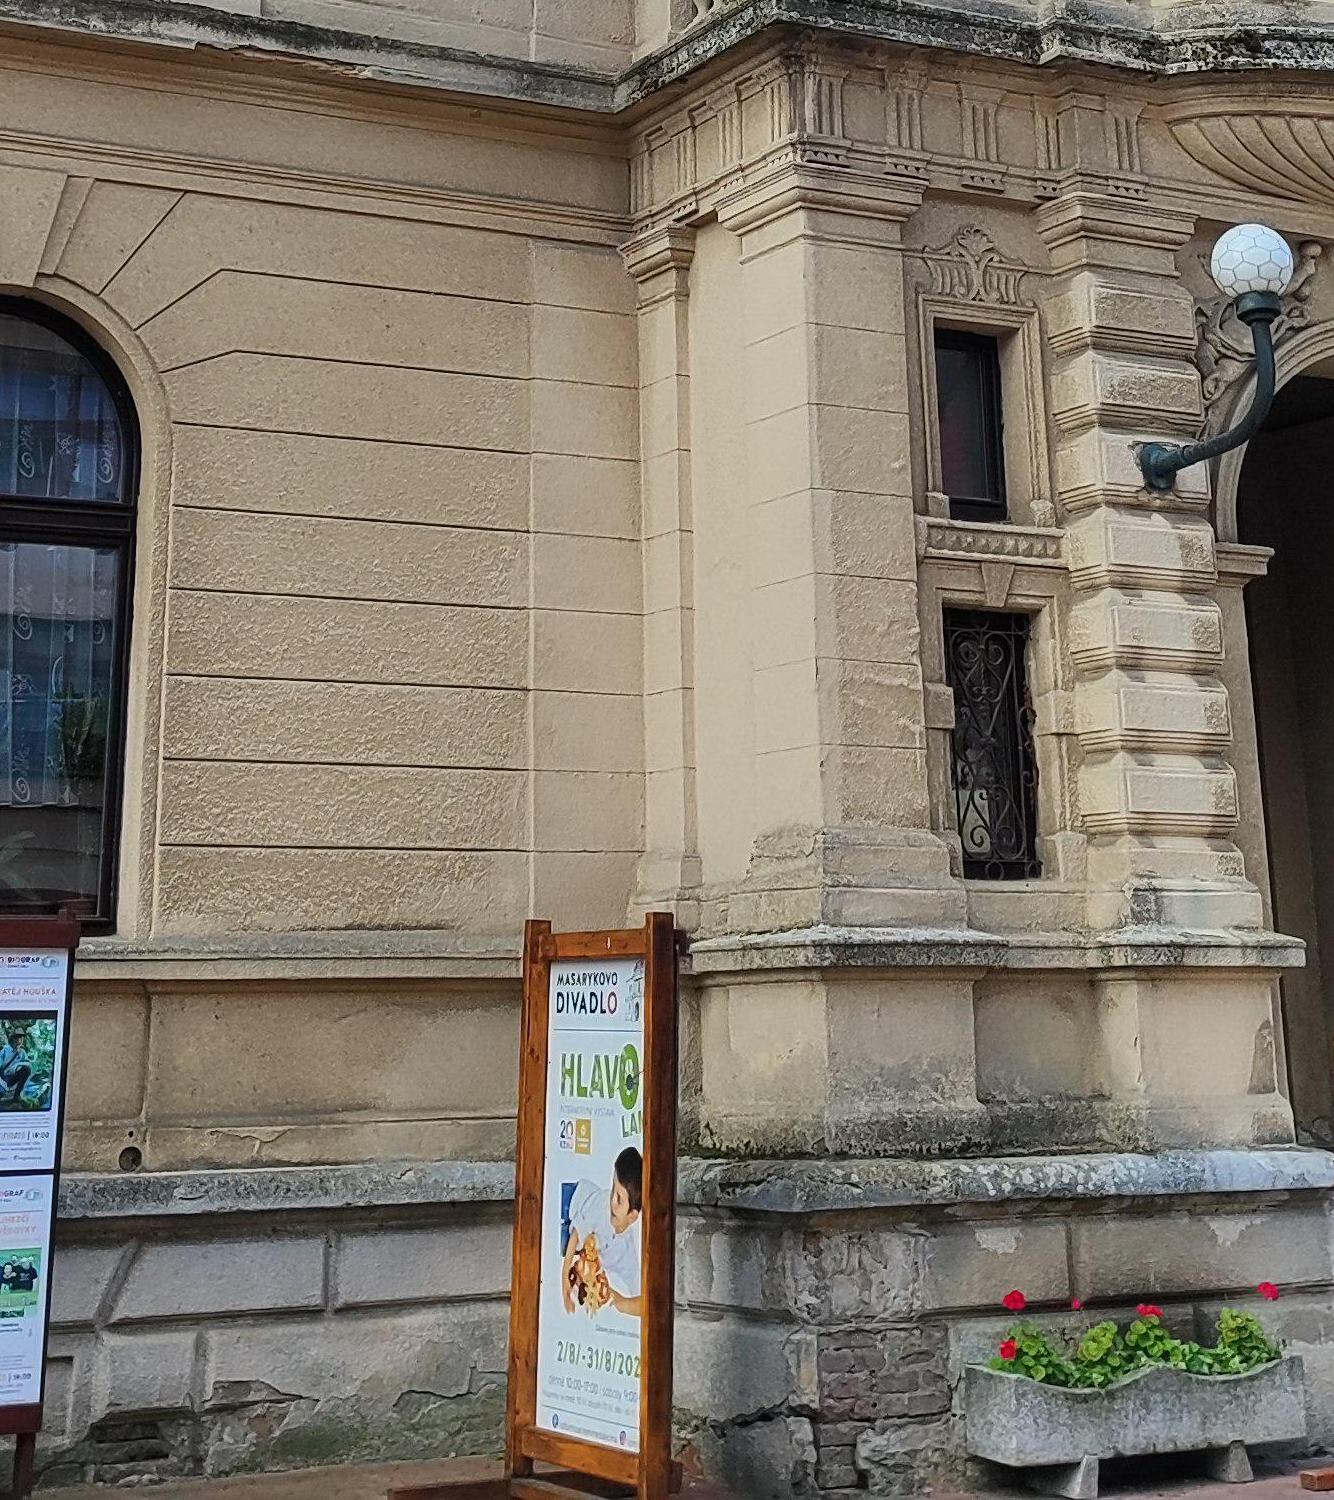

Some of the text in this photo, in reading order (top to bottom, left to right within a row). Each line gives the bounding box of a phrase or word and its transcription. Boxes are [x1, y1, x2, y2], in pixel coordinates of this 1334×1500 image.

[556, 971, 619, 987] MASARYKOVO
[556, 991, 618, 1015] DIVADLO
[560, 1043, 640, 1111] HLAVO
